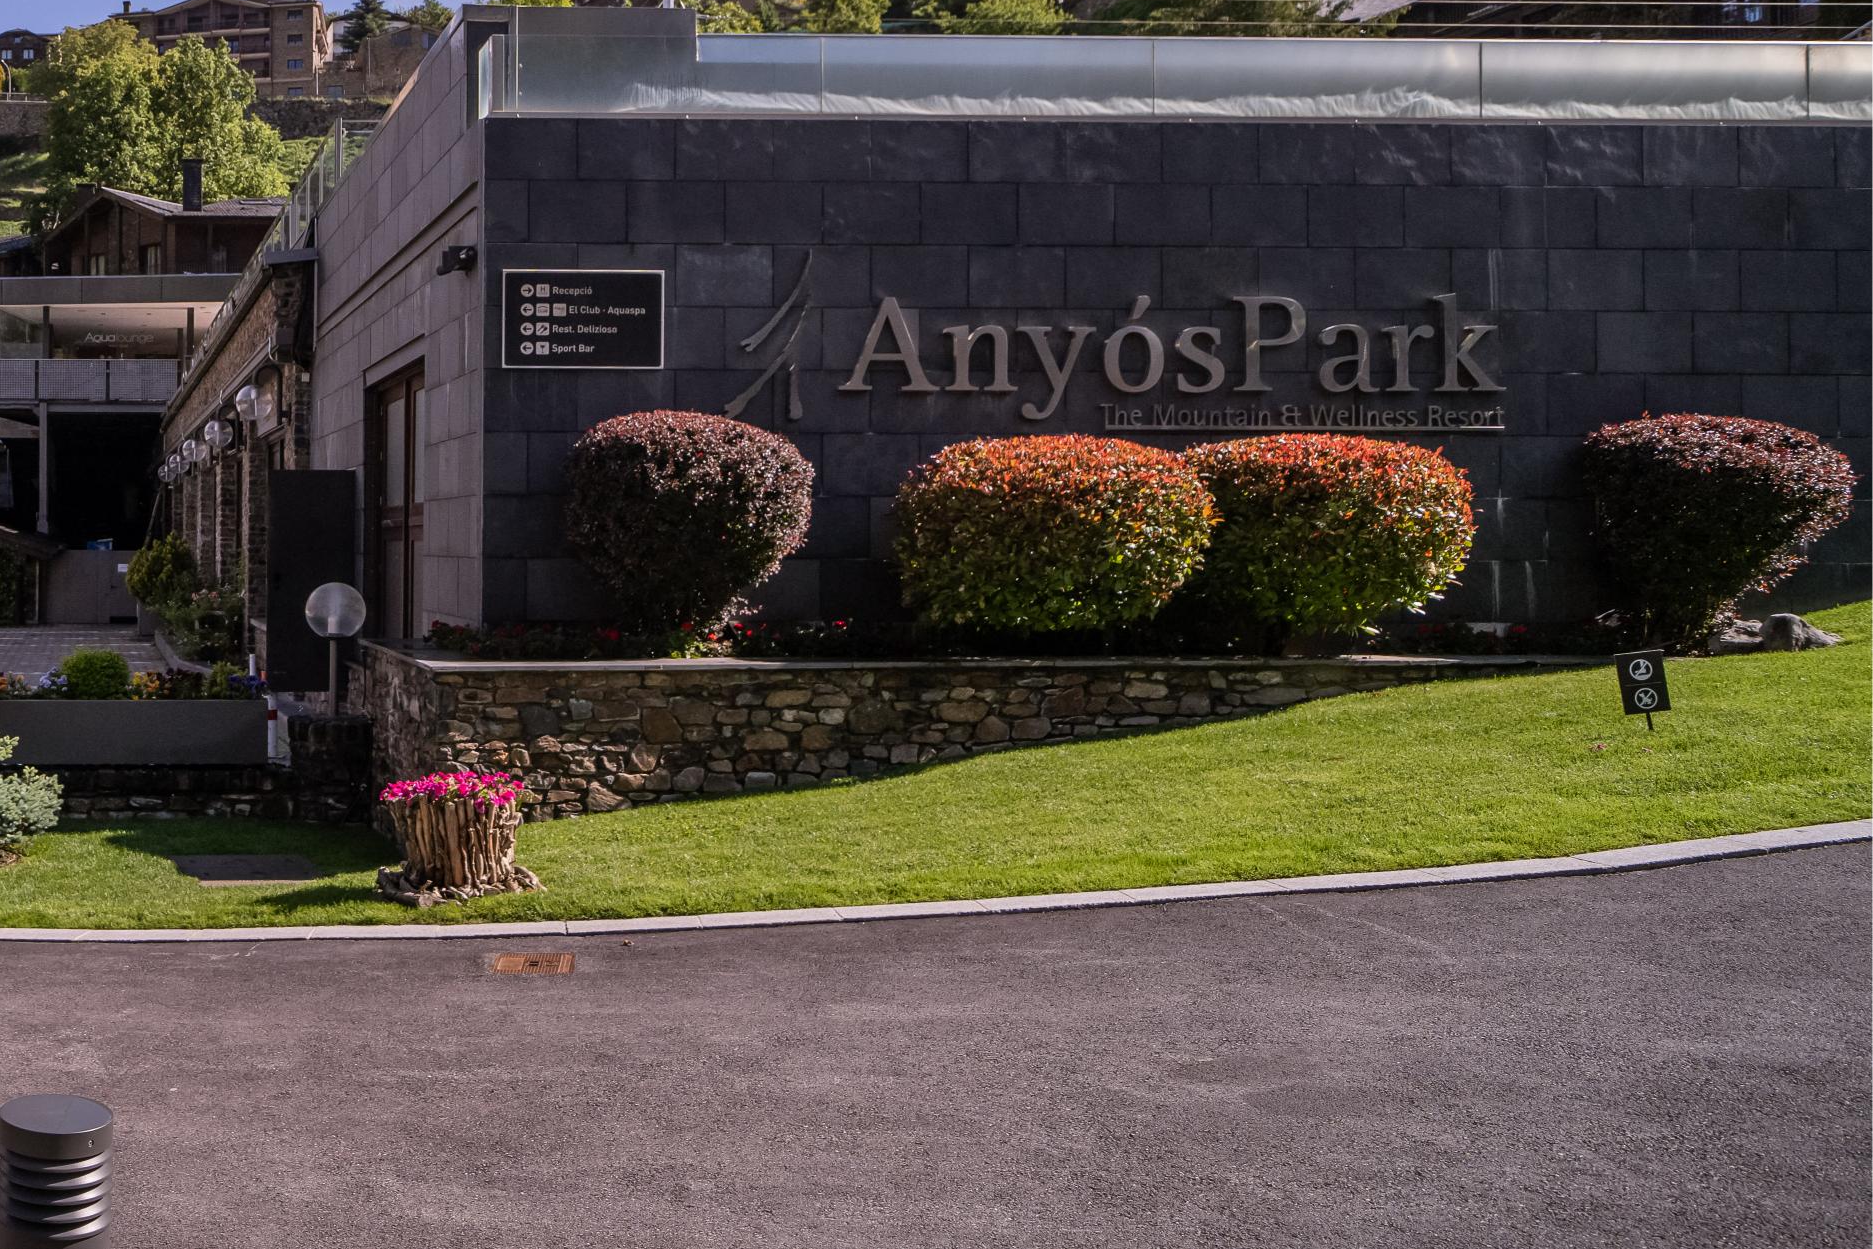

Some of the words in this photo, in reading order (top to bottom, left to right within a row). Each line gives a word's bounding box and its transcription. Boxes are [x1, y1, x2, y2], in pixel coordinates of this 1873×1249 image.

[552, 286, 592, 296] Recepció
[569, 306, 578, 314] El
[580, 306, 600, 314] Club
[607, 306, 646, 316] Aquaspa
[552, 325, 575, 333] Rest.
[577, 325, 618, 333] Delizioso
[551, 344, 576, 354] Sport
[578, 344, 595, 352] Bar
[1100, 403, 1143, 427] The
[1152, 403, 1271, 427] Mountain
[1280, 404, 1302, 427] &
[1310, 404, 1418, 428] Wellness
[1428, 405, 1505, 428] Resort
